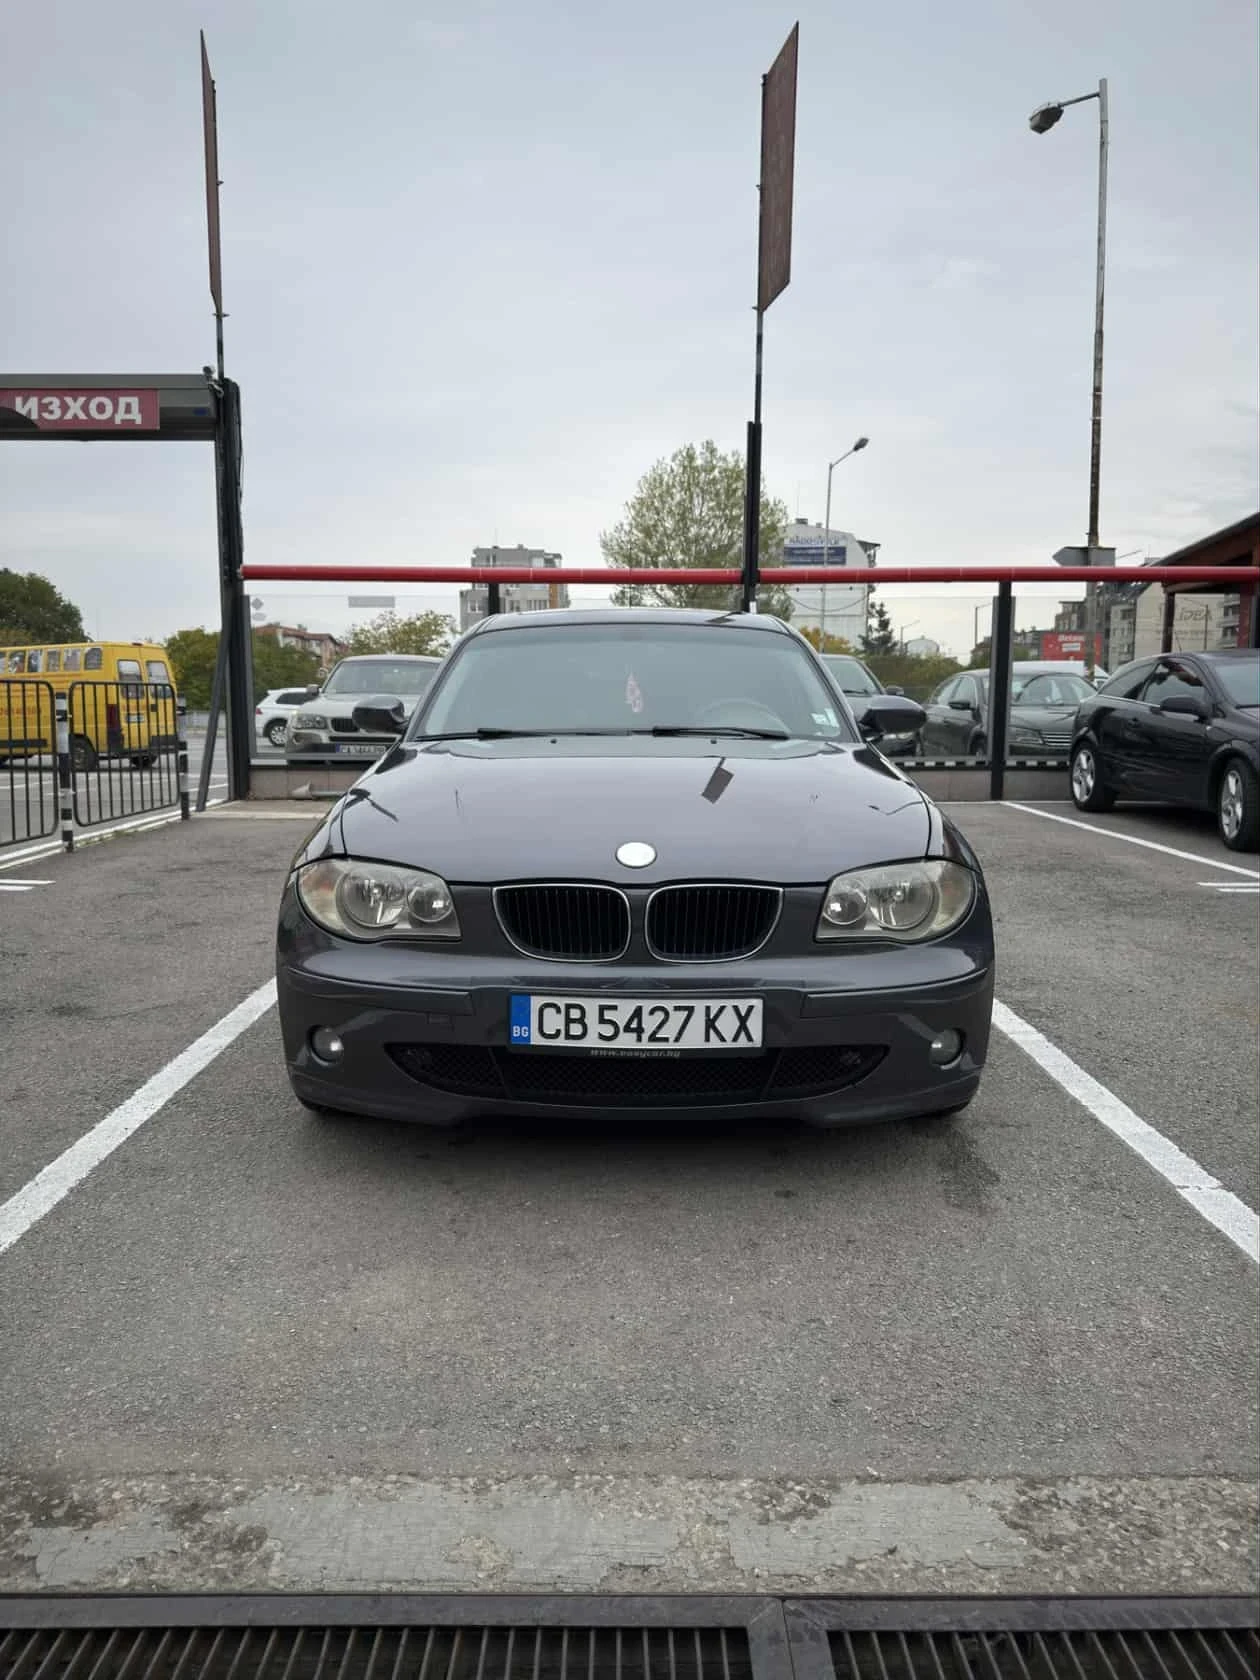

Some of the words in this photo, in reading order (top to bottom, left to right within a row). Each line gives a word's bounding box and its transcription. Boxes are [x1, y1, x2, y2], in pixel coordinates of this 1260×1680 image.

[14, 396, 142, 424] ИЗХОД
[513, 1026, 529, 1037] BG
[537, 1002, 588, 1041] CB
[597, 1004, 696, 1043] 5427
[704, 1005, 755, 1043] KX
